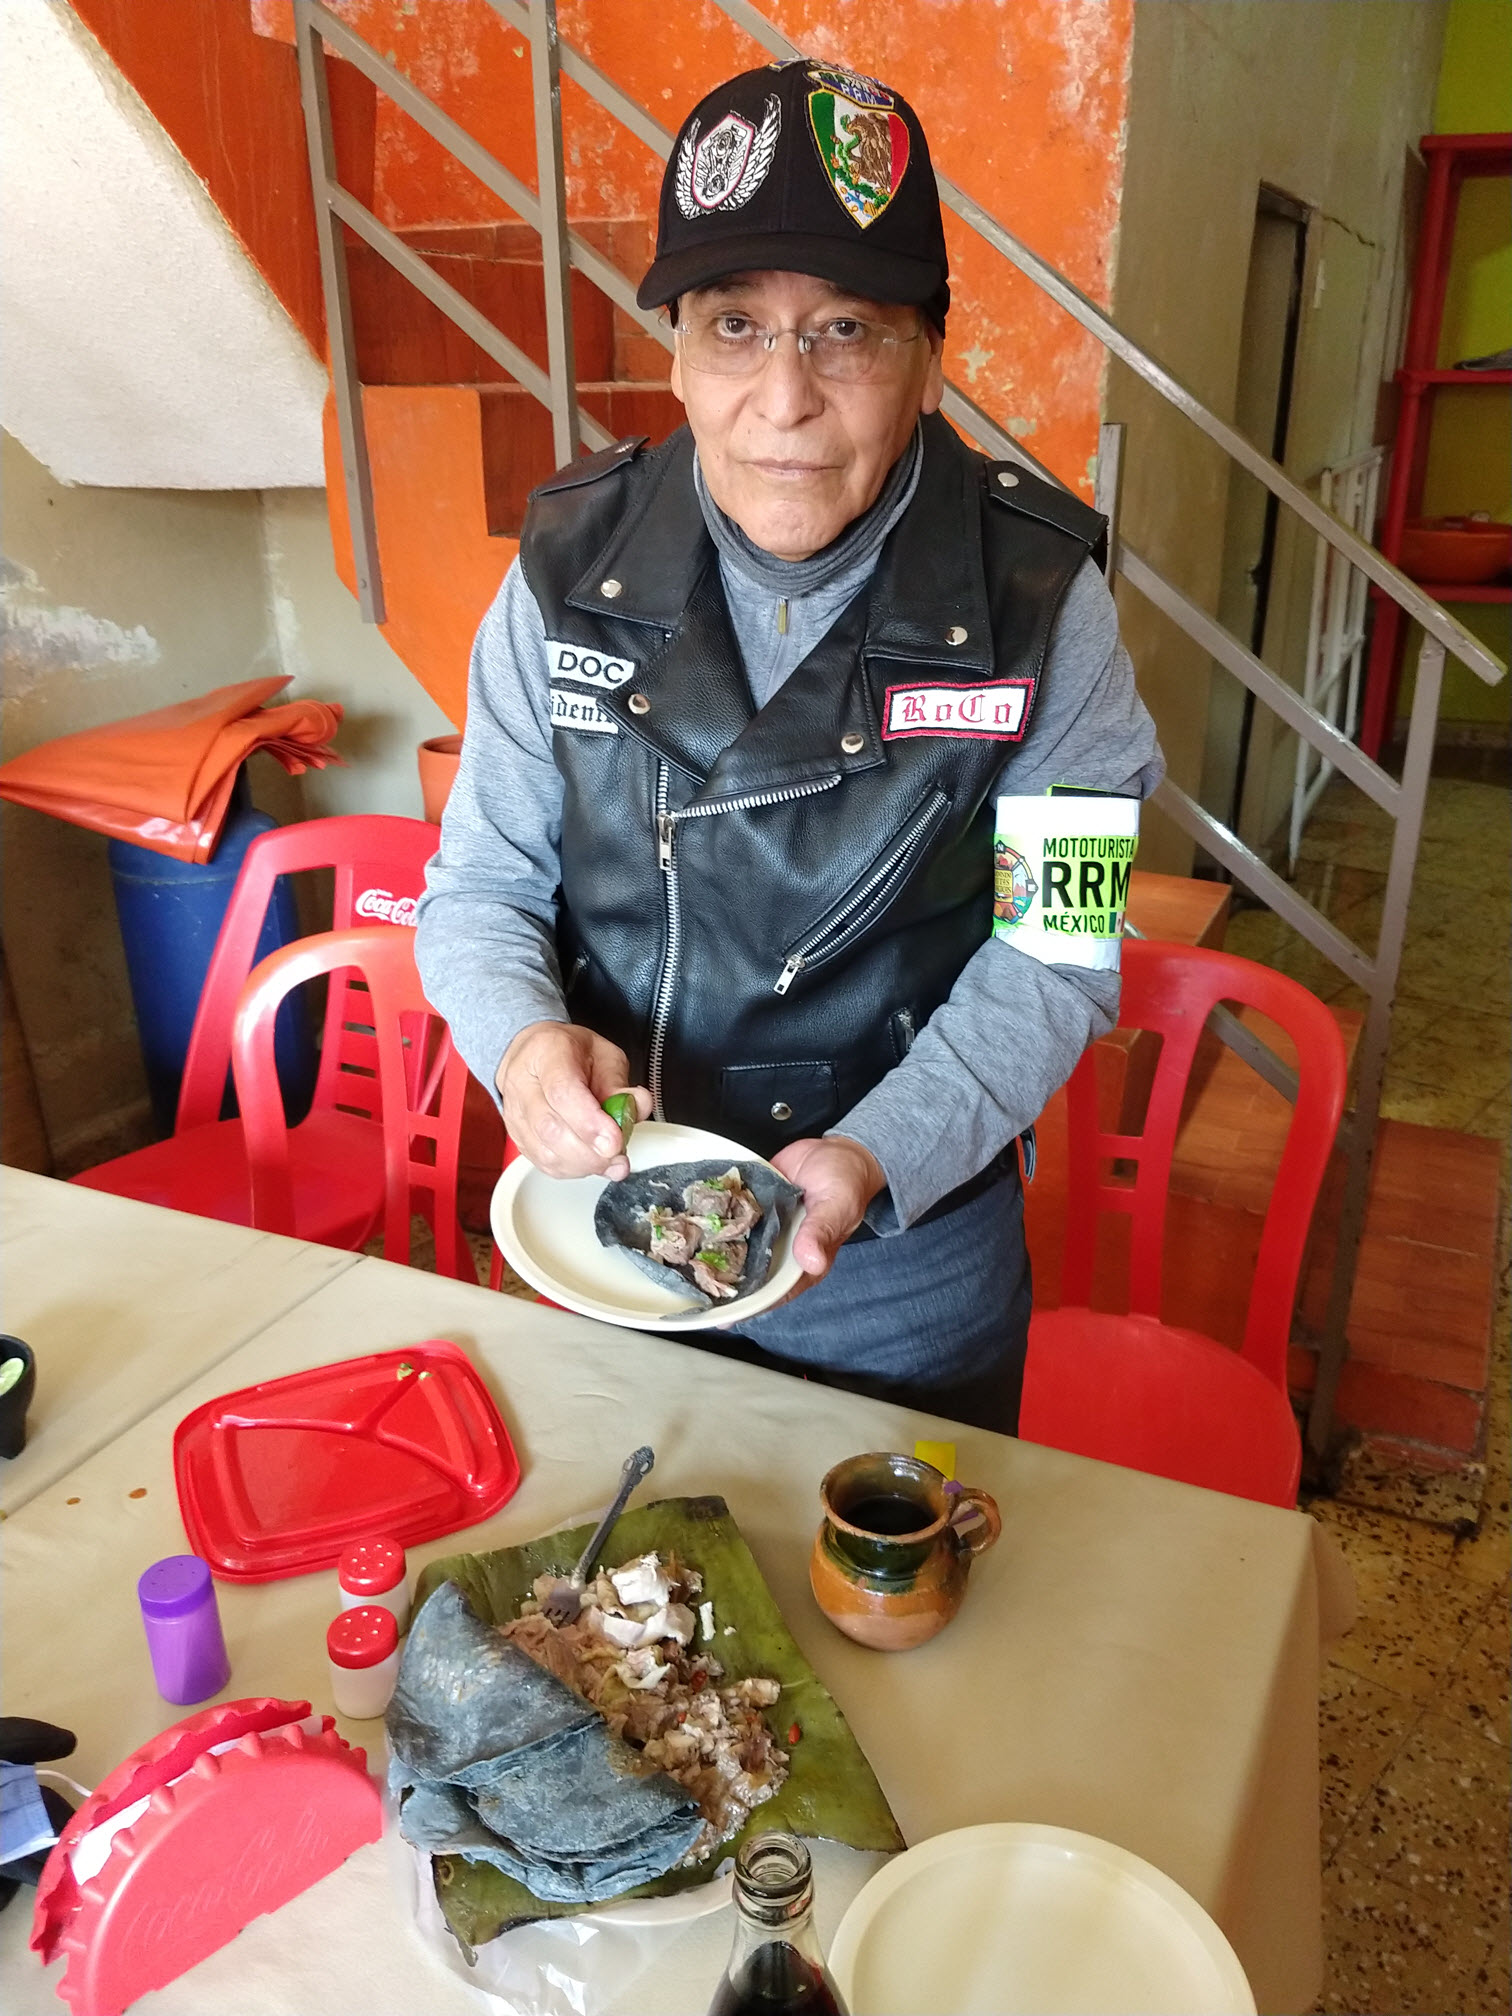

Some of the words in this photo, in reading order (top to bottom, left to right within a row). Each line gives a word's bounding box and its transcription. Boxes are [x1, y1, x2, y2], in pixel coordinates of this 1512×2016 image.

[558, 651, 624, 683] DOC
[902, 694, 1012, 724] RoCo
[1042, 861, 1132, 908] RRM
[1043, 911, 1105, 933] MÉXICO
